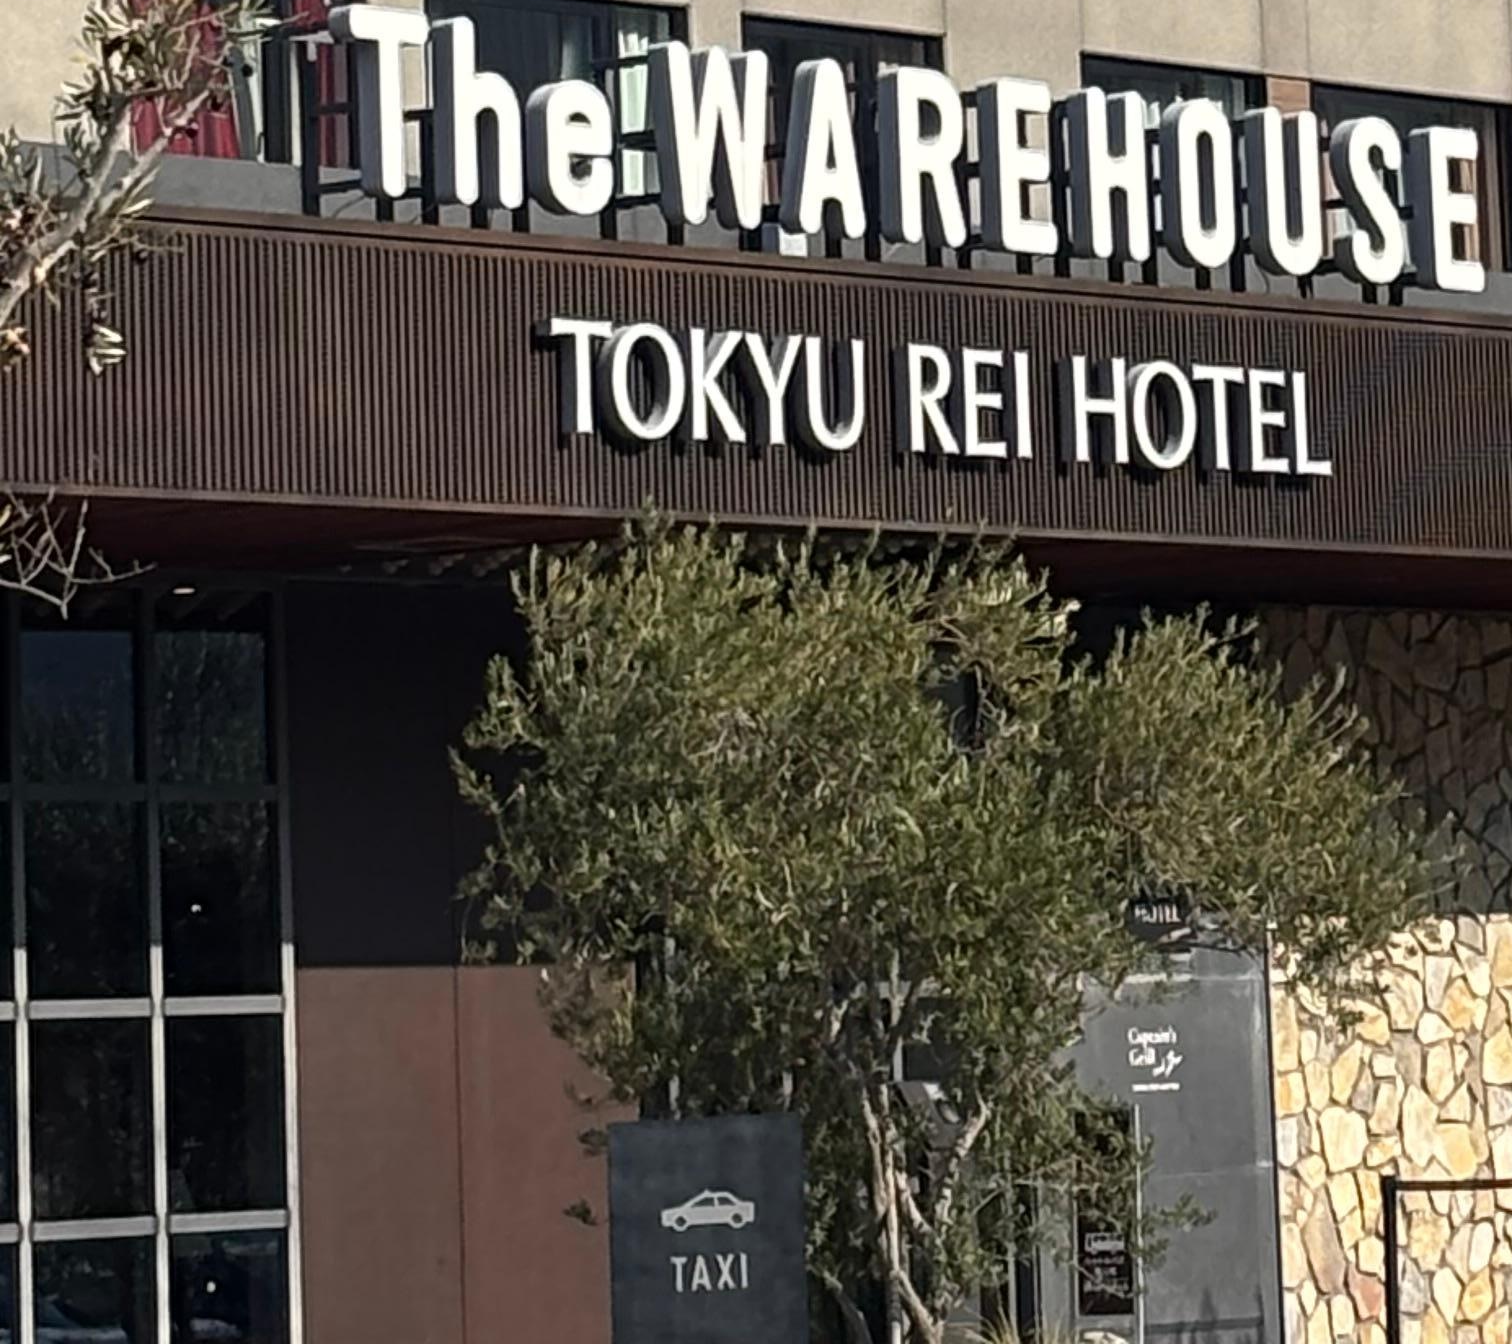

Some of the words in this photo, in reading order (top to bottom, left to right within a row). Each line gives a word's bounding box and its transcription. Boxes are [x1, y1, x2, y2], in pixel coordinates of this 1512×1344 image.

[328, 4, 616, 218] The
[648, 39, 1487, 294] WAREHOUSE
[549, 317, 866, 451] TOKYU
[908, 342, 1033, 459] REI
[1072, 355, 1333, 476] HOTEL
[669, 1252, 749, 1293] TAXI
